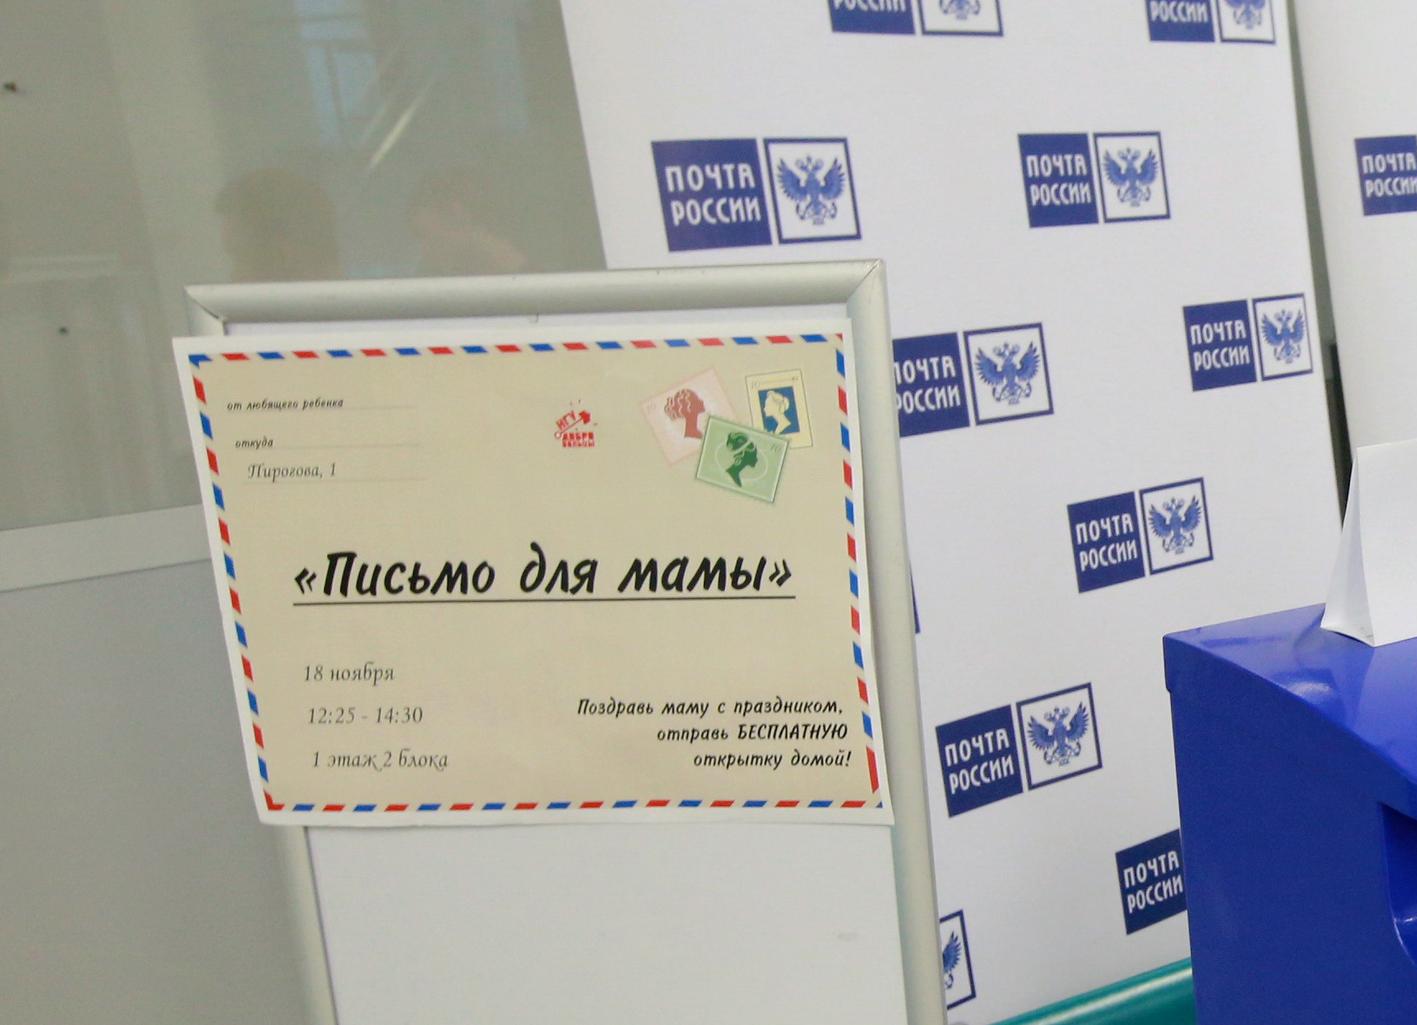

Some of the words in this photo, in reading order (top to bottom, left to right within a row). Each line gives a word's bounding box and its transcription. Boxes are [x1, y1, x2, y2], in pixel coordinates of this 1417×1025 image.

[1026, 153, 1088, 178] ПОЧТА
[1362, 152, 1417, 174] ПОЧТА
[665, 162, 756, 193] ПОЧТА
[1030, 181, 1092, 207] РОССИИ
[671, 196, 762, 227] РОССИИ
[1190, 320, 1247, 346] ПОЧТА
[1193, 345, 1251, 371] РОССИИ
[227, 402, 242, 411] от
[247, 398, 298, 412] любящего
[302, 397, 344, 411] ребенка
[235, 436, 274, 450] откуда
[248, 463, 323, 483] Пирогова,
[329, 462, 336, 476] 1
[1075, 513, 1134, 545] ПОЧТА
[1079, 539, 1138, 572] РОССИИ
[294, 551, 496, 598] «Письмо
[520, 541, 598, 595] для
[617, 556, 792, 594] мамы»
[304, 664, 324, 682] 18
[330, 661, 395, 687] ноября
[308, 706, 356, 724] 12:25
[376, 706, 424, 724] 14:30
[577, 697, 654, 718] Поздравь
[661, 700, 710, 719] маму
[717, 702, 726, 715] с
[733, 696, 844, 717] праздником,
[656, 726, 729, 744] отправь
[737, 723, 848, 741] БЕСПЛАТНУЮ
[312, 751, 321, 768] 1
[327, 753, 383, 772] этаж
[383, 750, 393, 768] 2
[398, 748, 449, 772] блока
[693, 752, 783, 771] открытку
[790, 748, 852, 768] домой!
[944, 727, 1011, 767] ПОЧТА
[949, 754, 1015, 795] РОССИИ
[1123, 850, 1180, 889] ПОЧТА
[1127, 874, 1183, 914] РОССИИ
